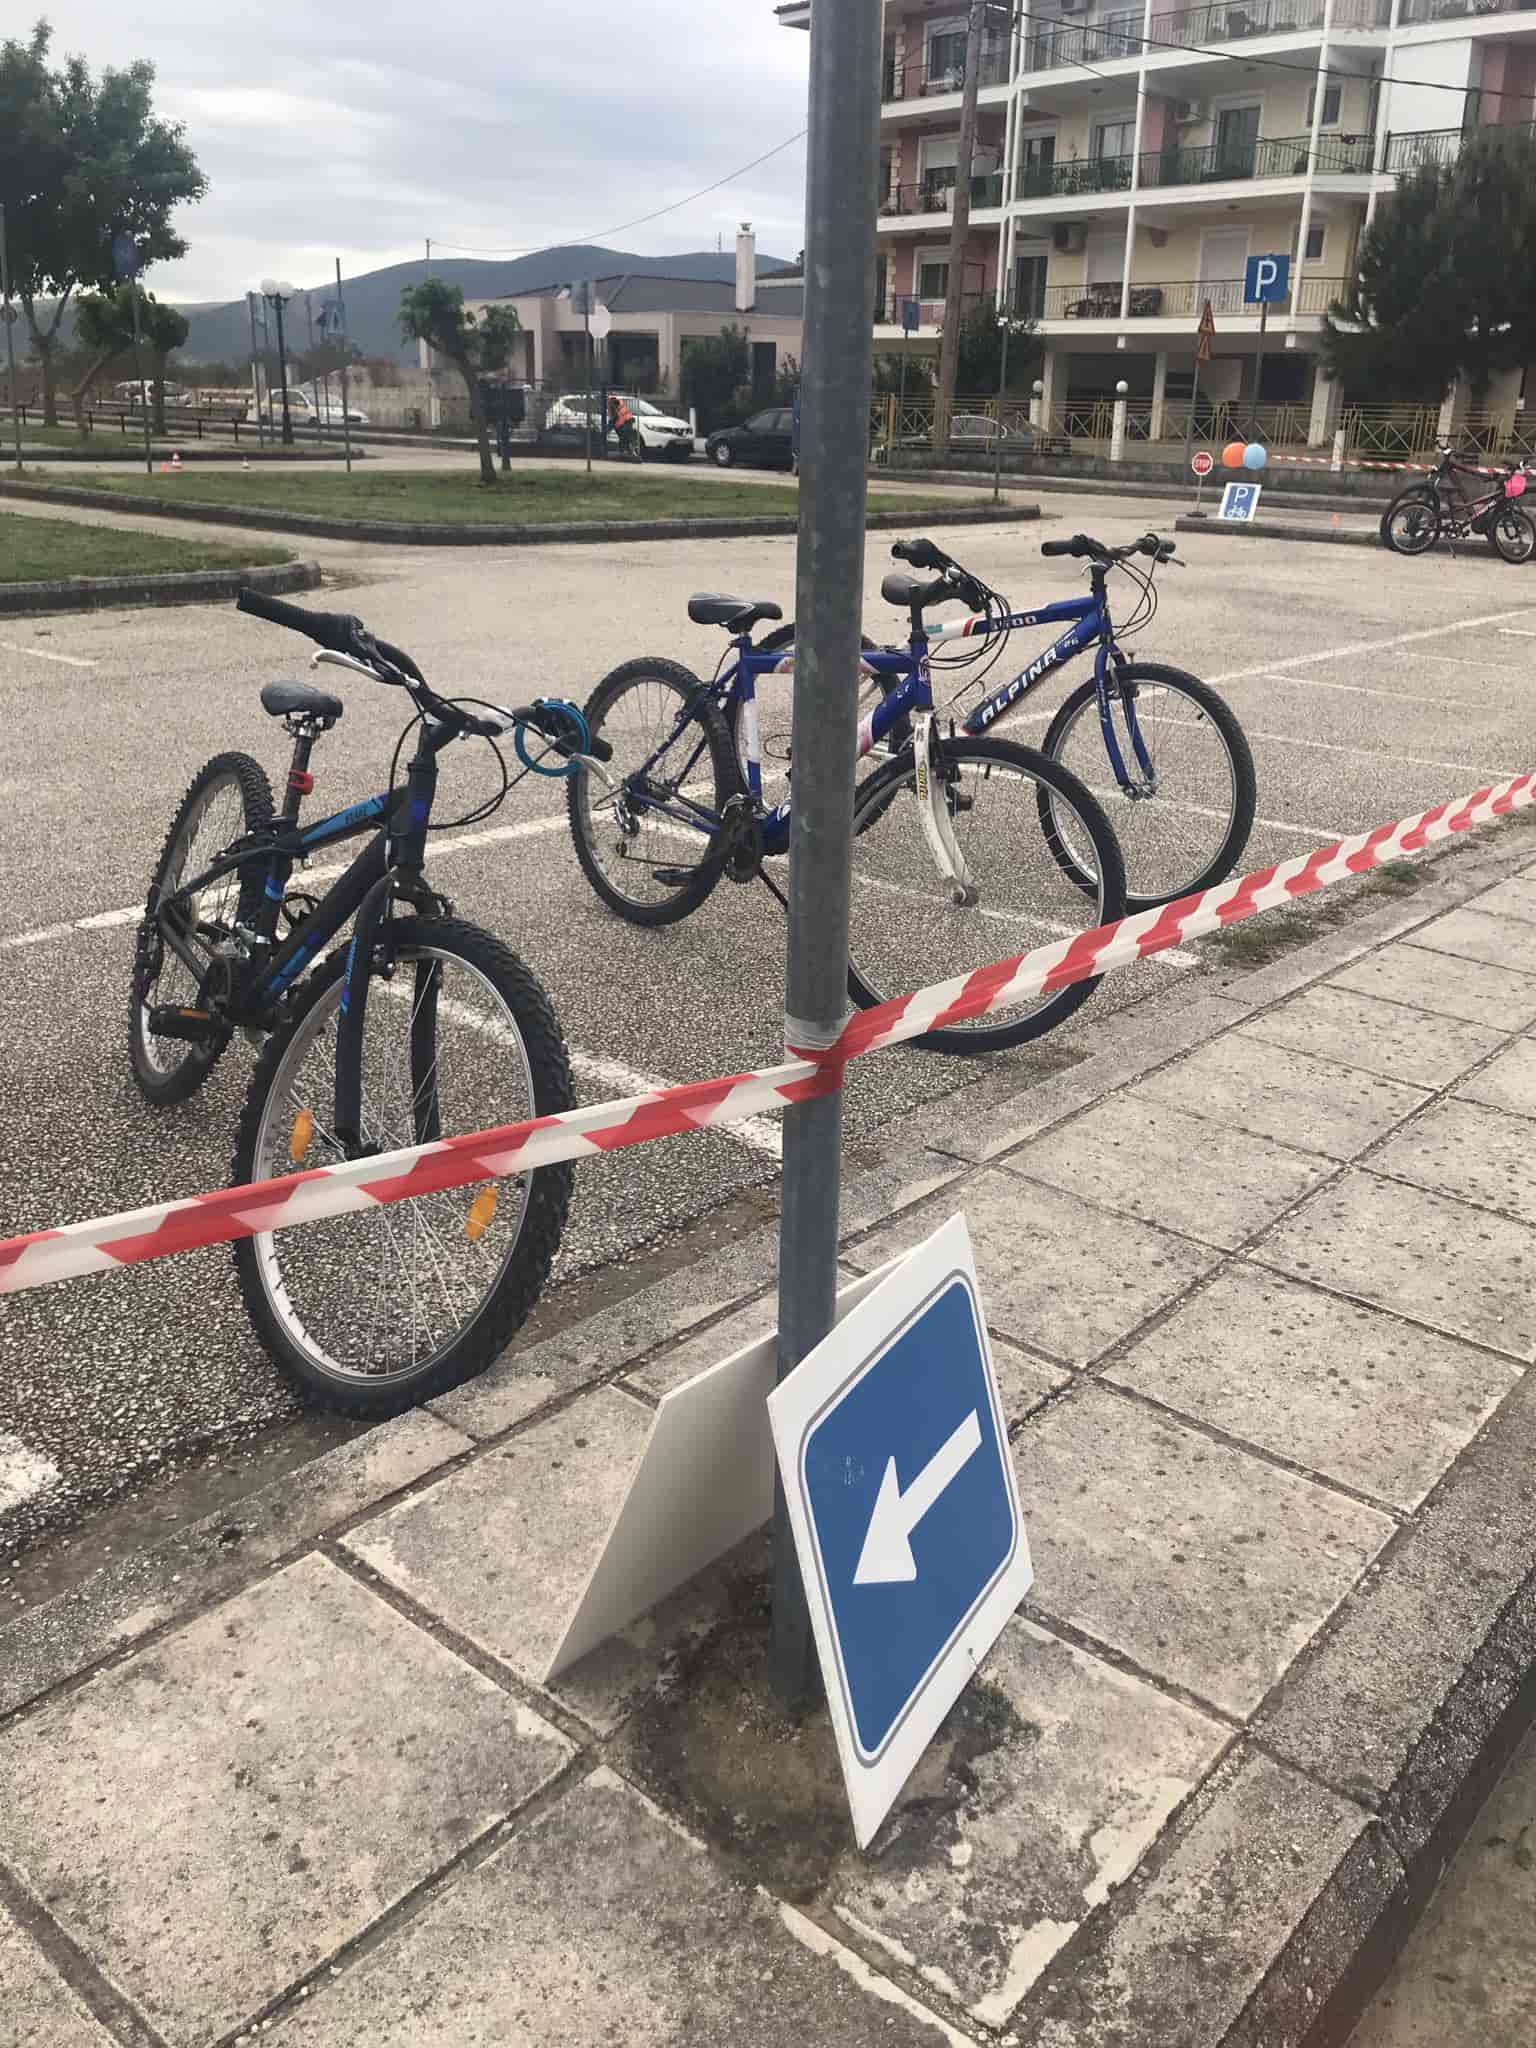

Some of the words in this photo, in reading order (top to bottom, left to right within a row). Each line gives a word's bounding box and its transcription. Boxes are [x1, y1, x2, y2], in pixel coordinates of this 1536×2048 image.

[1255, 260, 1277, 299] P
[1195, 458, 1210, 468] STOP
[1234, 487, 1249, 503] P
[981, 647, 1058, 725] ALPINA
